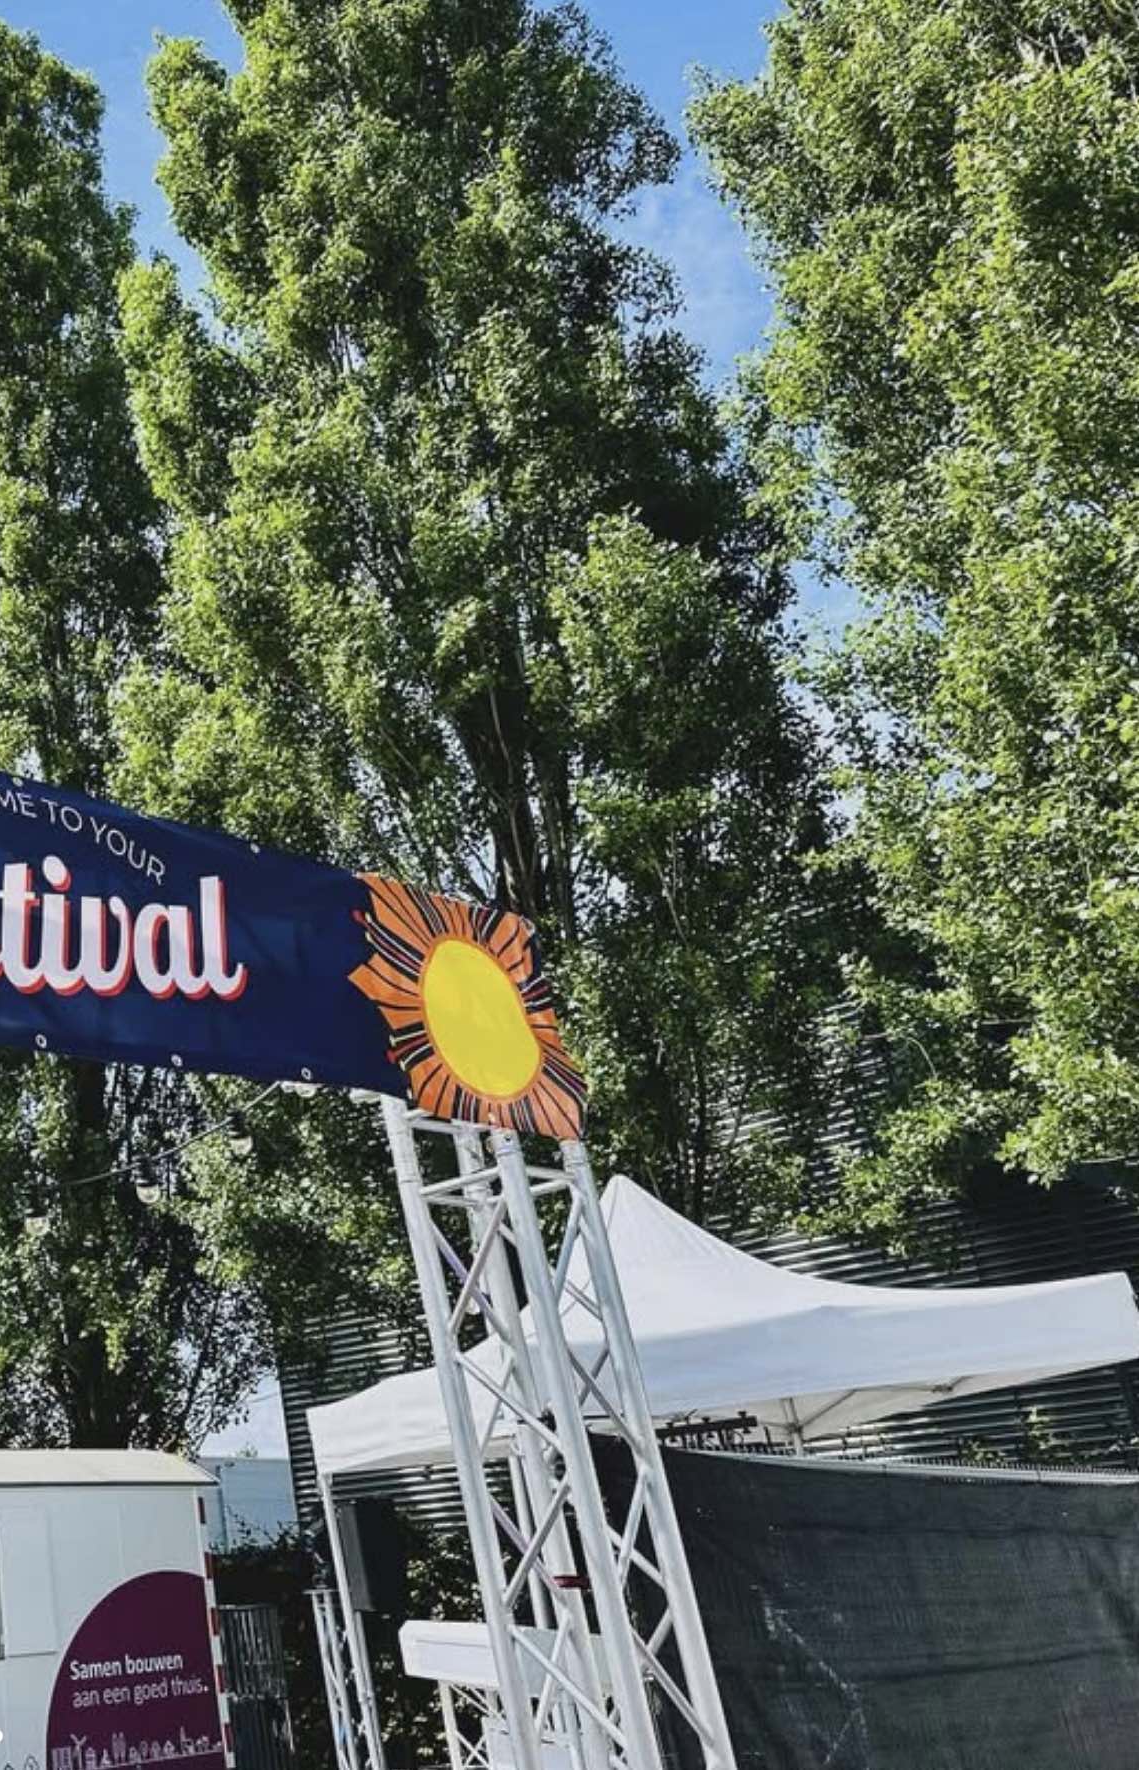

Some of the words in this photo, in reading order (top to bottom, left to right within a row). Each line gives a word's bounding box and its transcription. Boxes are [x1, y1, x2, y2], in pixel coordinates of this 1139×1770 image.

[41, 796, 84, 833] TO
[89, 820, 167, 887] YOUR
[70, 1660, 122, 1681] Samen
[125, 1653, 183, 1674] bouwen
[72, 1689, 100, 1708] aan
[103, 1686, 130, 1704] een
[134, 1678, 168, 1705] goed
[171, 1675, 209, 1696] thuis.
